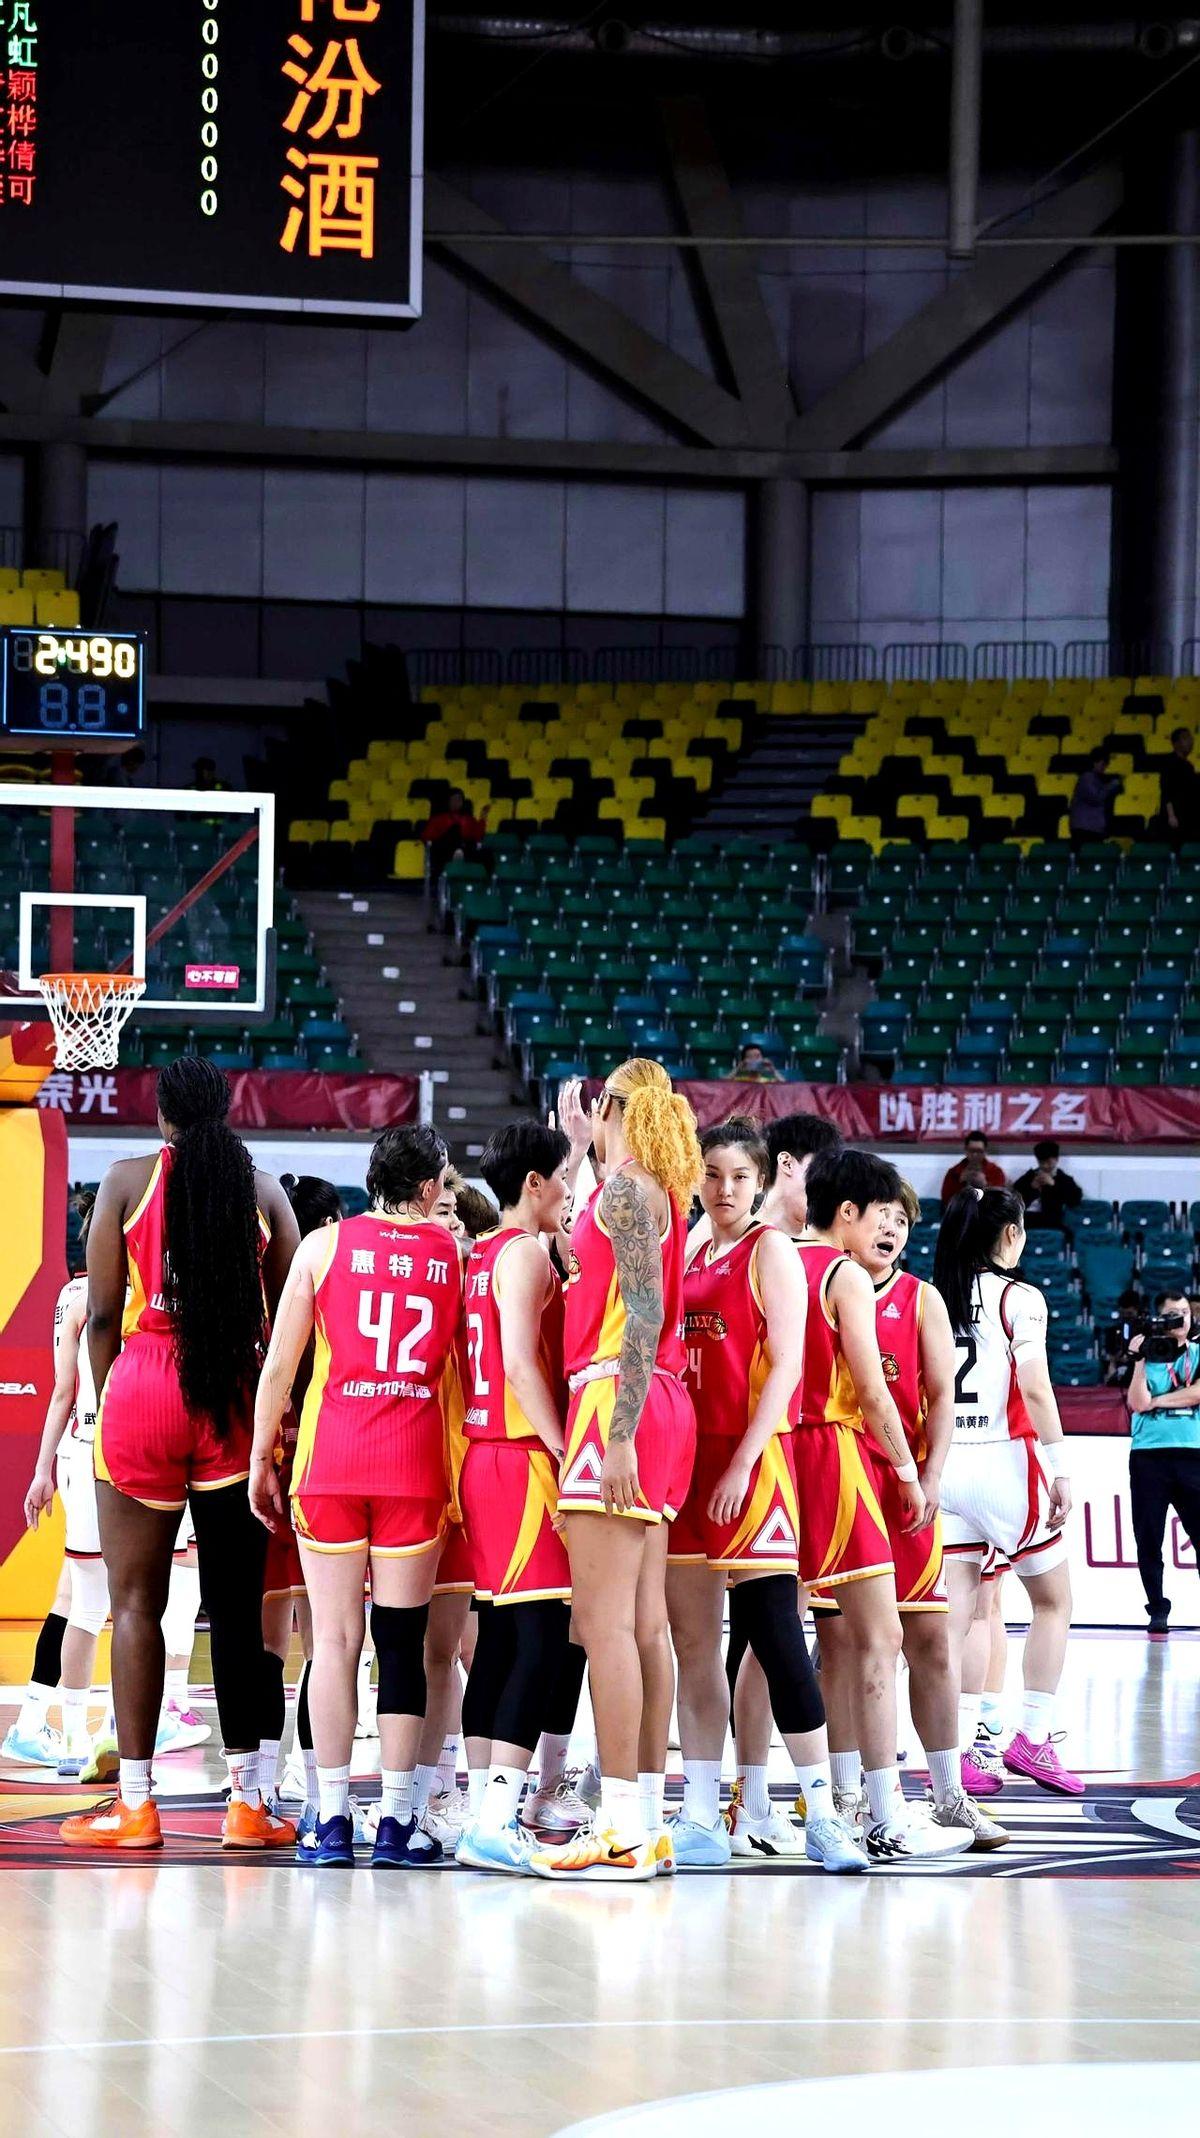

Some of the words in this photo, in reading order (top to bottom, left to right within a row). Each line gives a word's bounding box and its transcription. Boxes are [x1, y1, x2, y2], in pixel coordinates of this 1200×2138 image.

[0, 1, 38, 33] 凡
[202, 19, 219, 45] 0
[202, 53, 219, 79] 0
[0, 69, 37, 102] 颖
[201, 87, 218, 113] 0
[0, 103, 36, 137] 桦
[201, 121, 218, 148] 0
[0, 139, 36, 172] 倩
[200, 155, 218, 182] 0
[0, 174, 36, 206] 可
[200, 189, 218, 216] 0
[879, 1093, 1087, 1132] 以胜利之名
[351, 1250, 448, 1284] 惠特尔
[357, 1290, 433, 1375] 42
[467, 1313, 490, 1396] 2
[685, 1348, 703, 1390] 4
